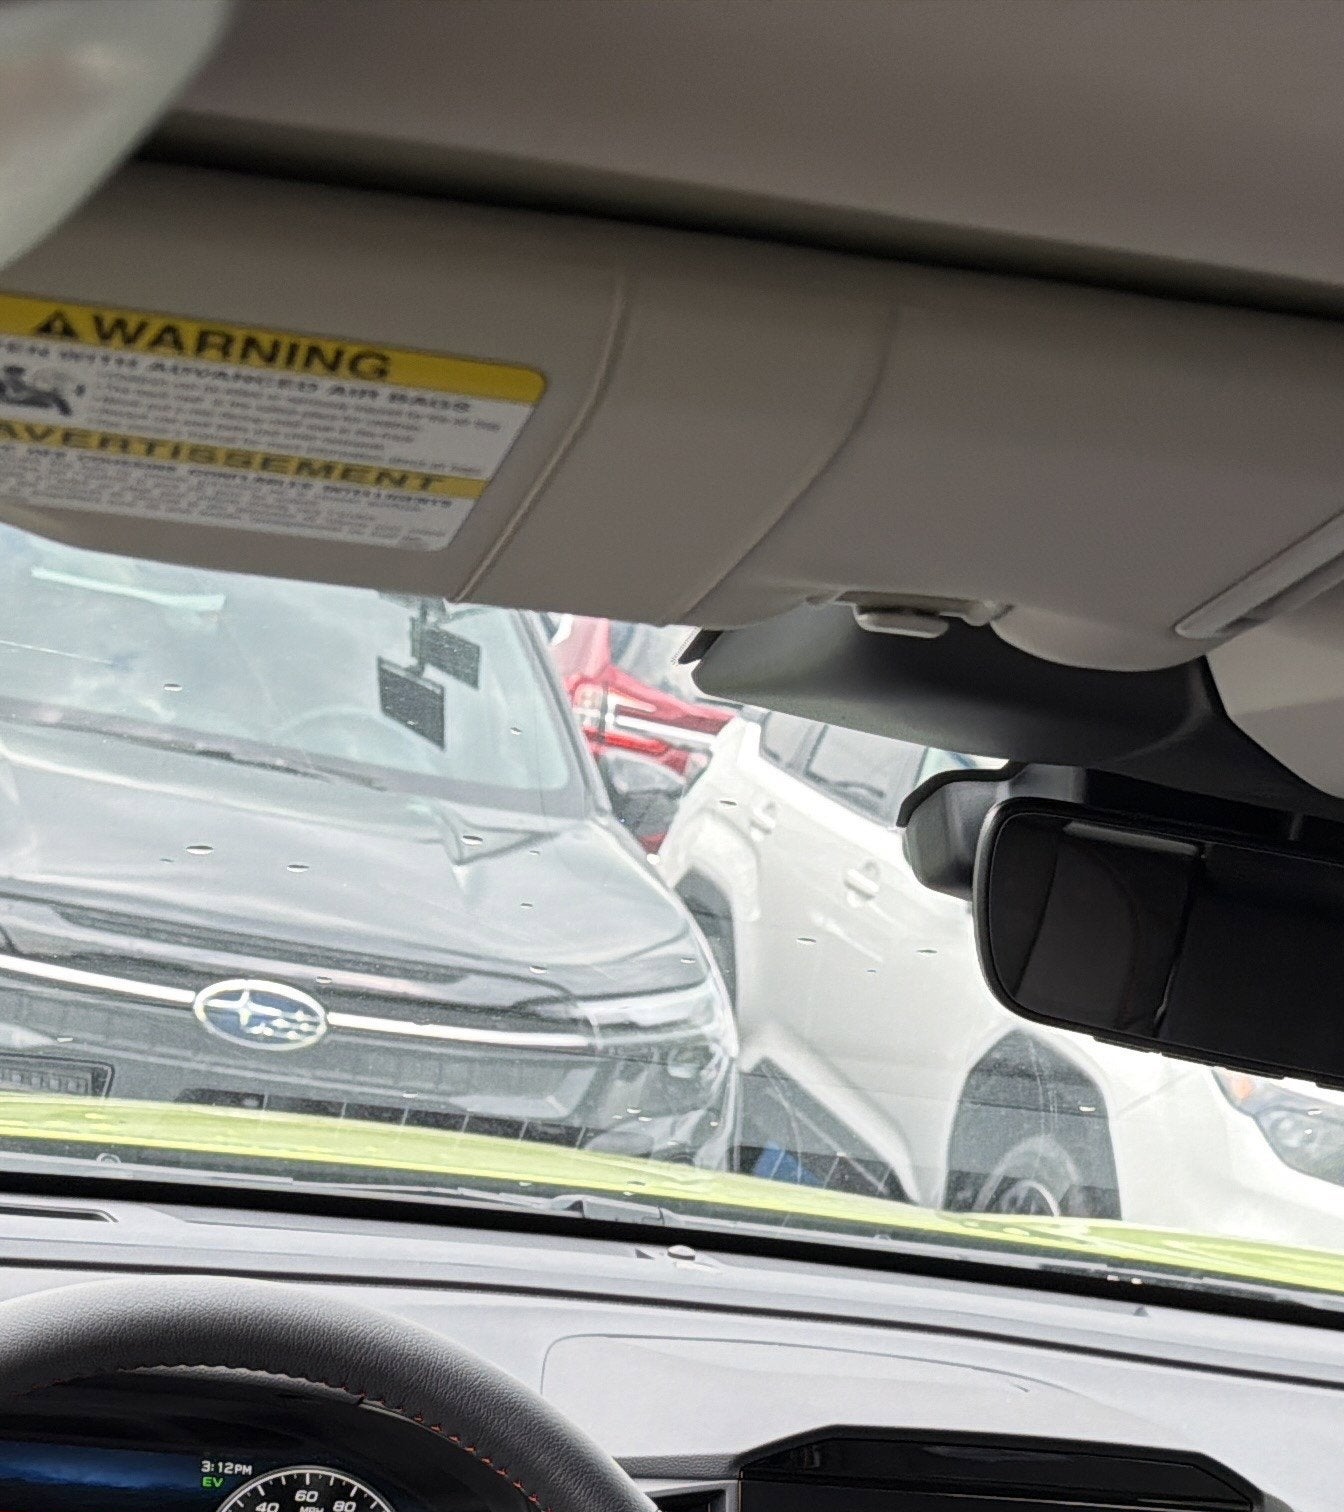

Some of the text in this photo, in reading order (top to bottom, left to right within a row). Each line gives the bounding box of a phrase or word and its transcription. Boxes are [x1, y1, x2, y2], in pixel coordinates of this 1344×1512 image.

[91, 313, 391, 381] WARNING
[202, 1476, 224, 1489] EV
[294, 1490, 319, 1503] 60
